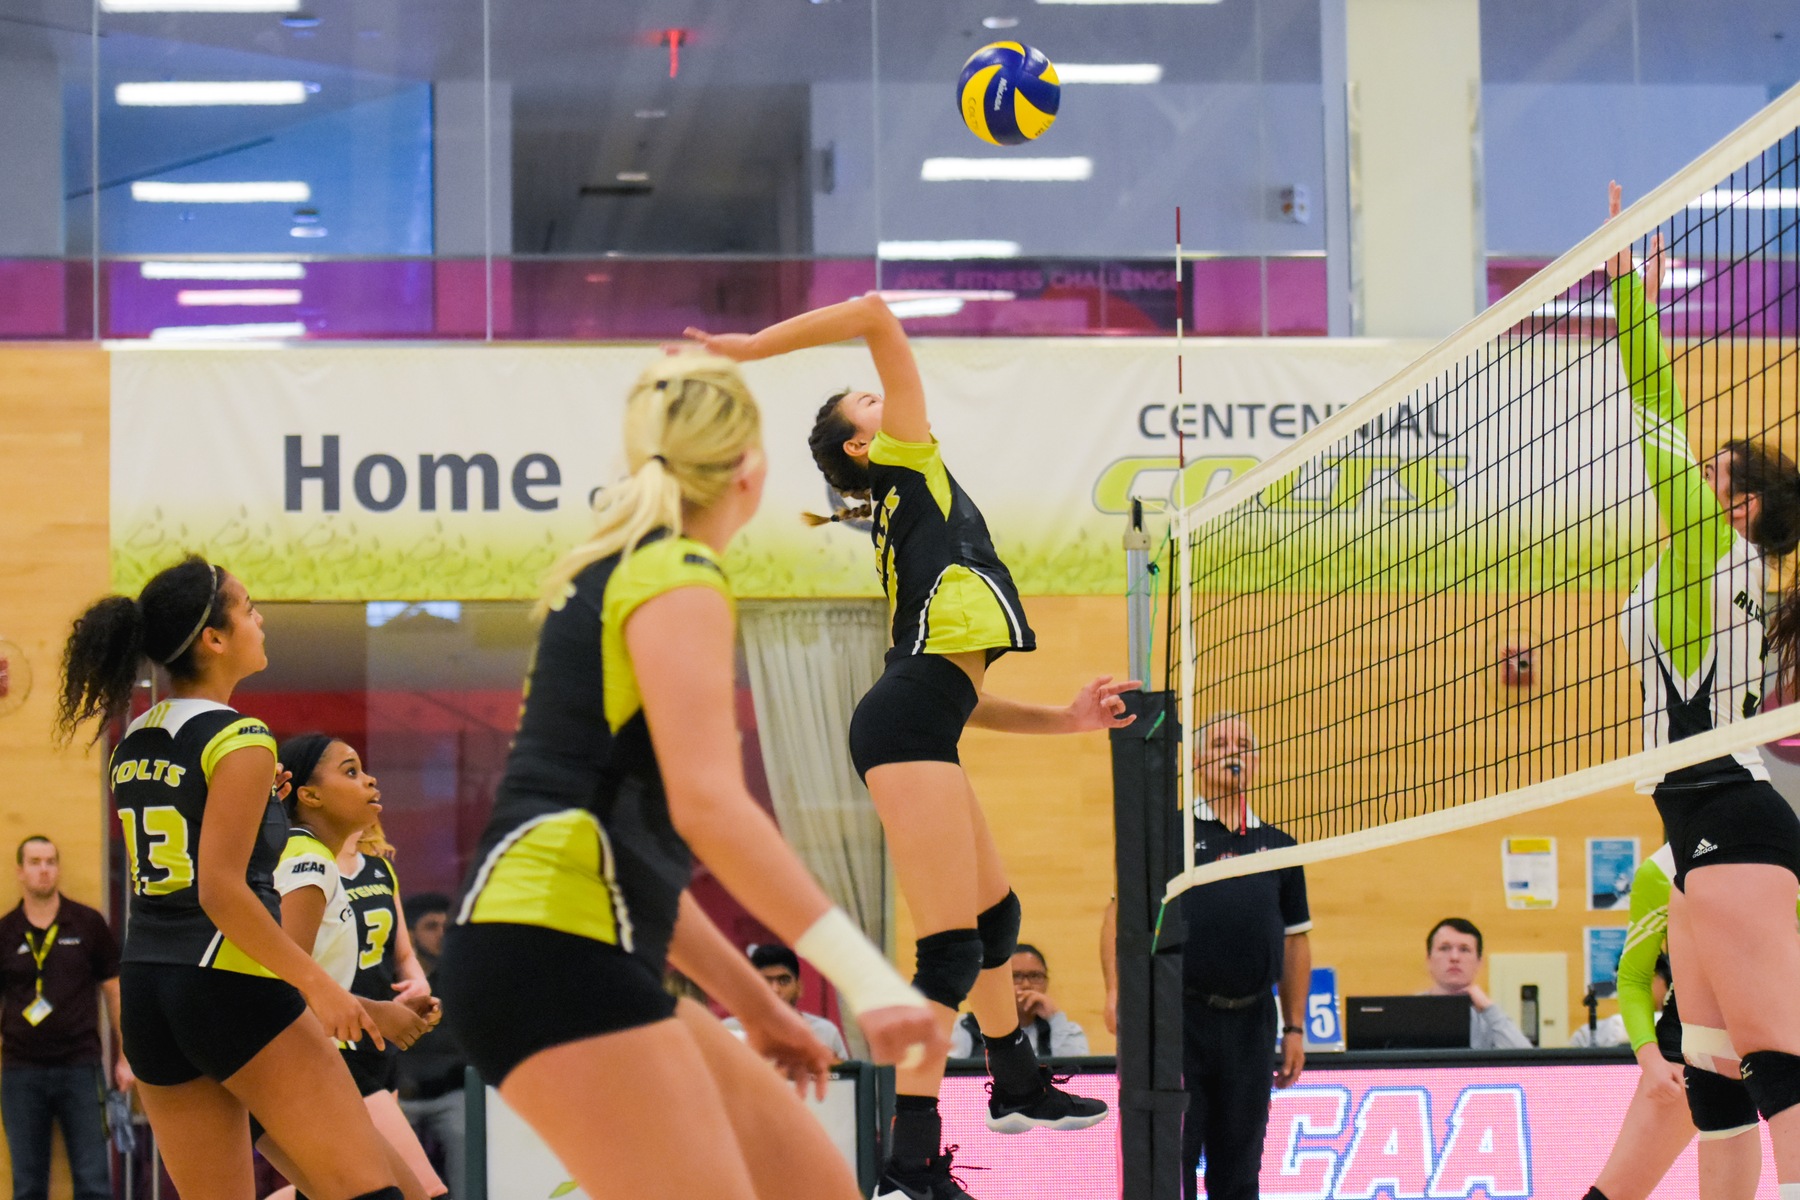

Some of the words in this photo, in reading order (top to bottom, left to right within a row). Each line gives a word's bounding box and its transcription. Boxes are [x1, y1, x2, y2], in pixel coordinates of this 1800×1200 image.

[954, 269, 1043, 291] FITNESS
[1138, 403, 1451, 440] CENTENIAL
[284, 435, 562, 512] Home
[117, 805, 195, 897] 13
[1692, 844, 1719, 859] adidas
[1309, 993, 1336, 1039] 5
[1196, 1083, 1534, 1200] CAA
